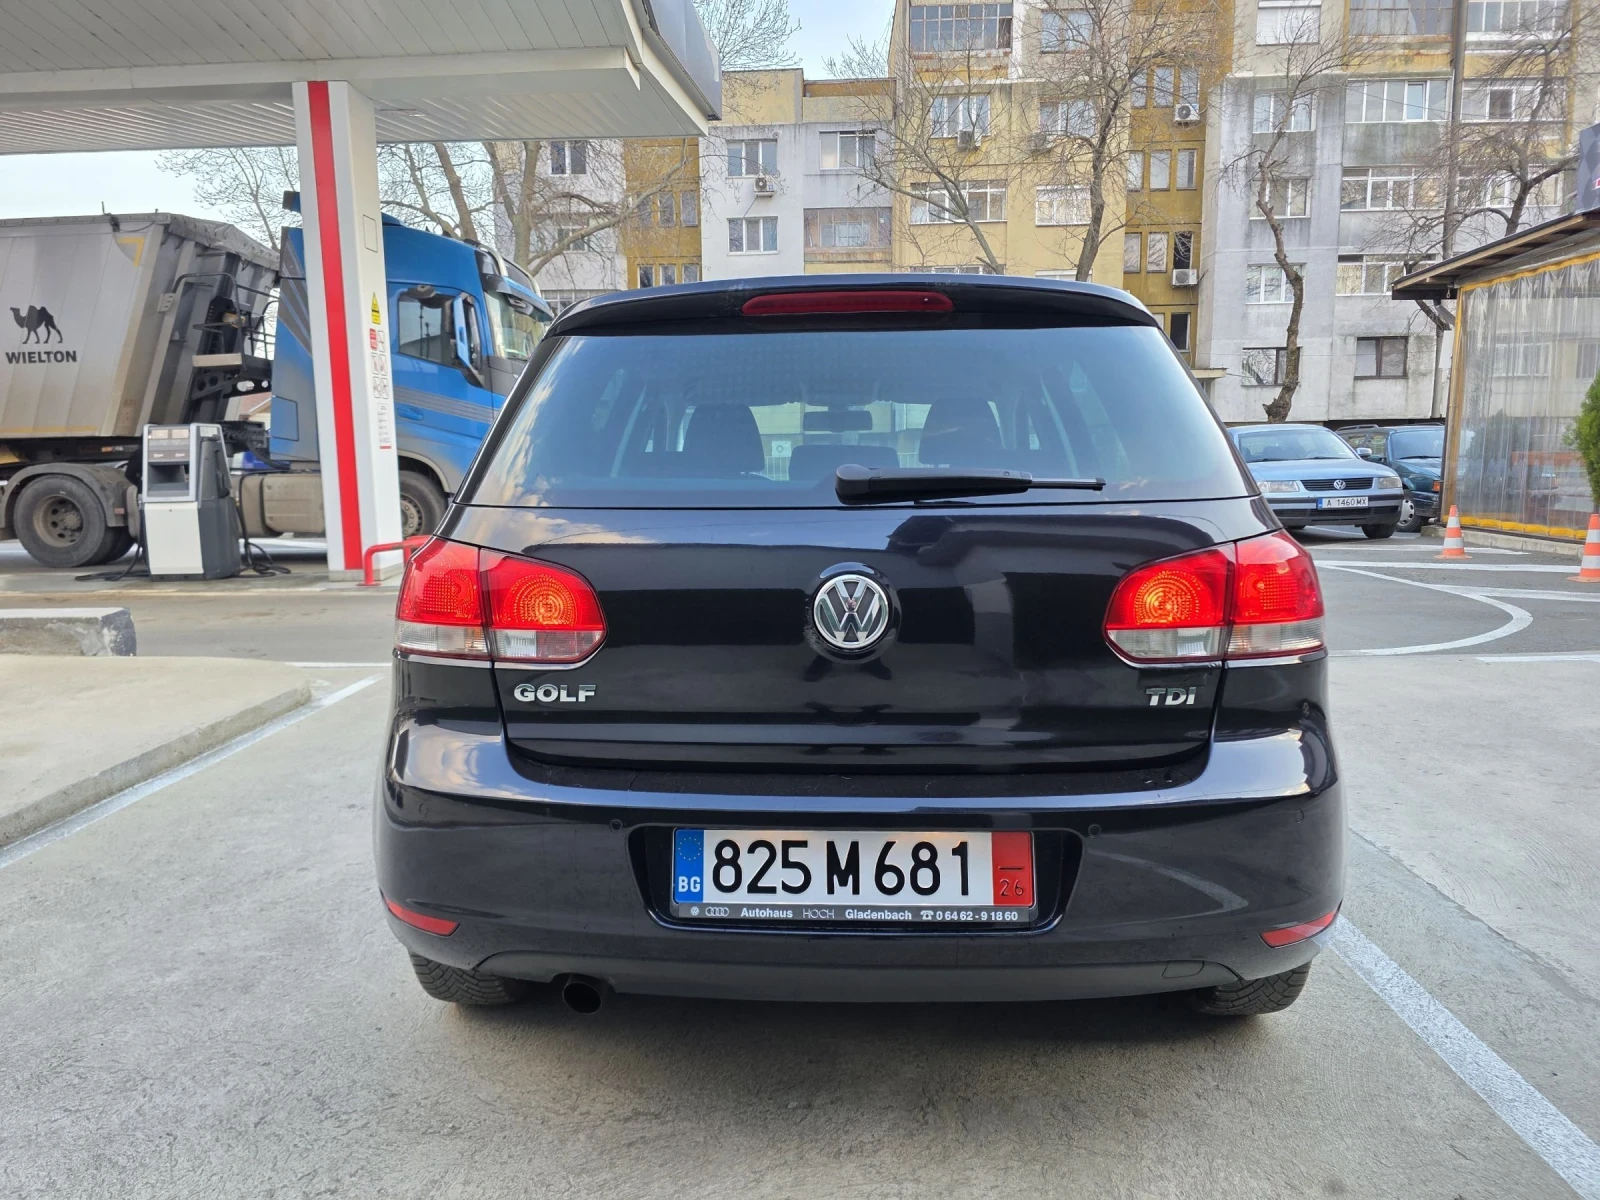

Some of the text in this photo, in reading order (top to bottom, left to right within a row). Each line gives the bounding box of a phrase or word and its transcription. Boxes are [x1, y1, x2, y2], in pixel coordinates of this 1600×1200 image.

[6, 350, 77, 364] WIELTON
[1326, 499, 1332, 507] A
[513, 683, 597, 703] GOLF
[711, 839, 970, 896] 825 M 681
[678, 876, 701, 893] BG
[999, 878, 1024, 897] 26
[740, 907, 793, 918] Autohaus
[802, 909, 835, 919] HOCH
[844, 909, 912, 920] Gladenbach
